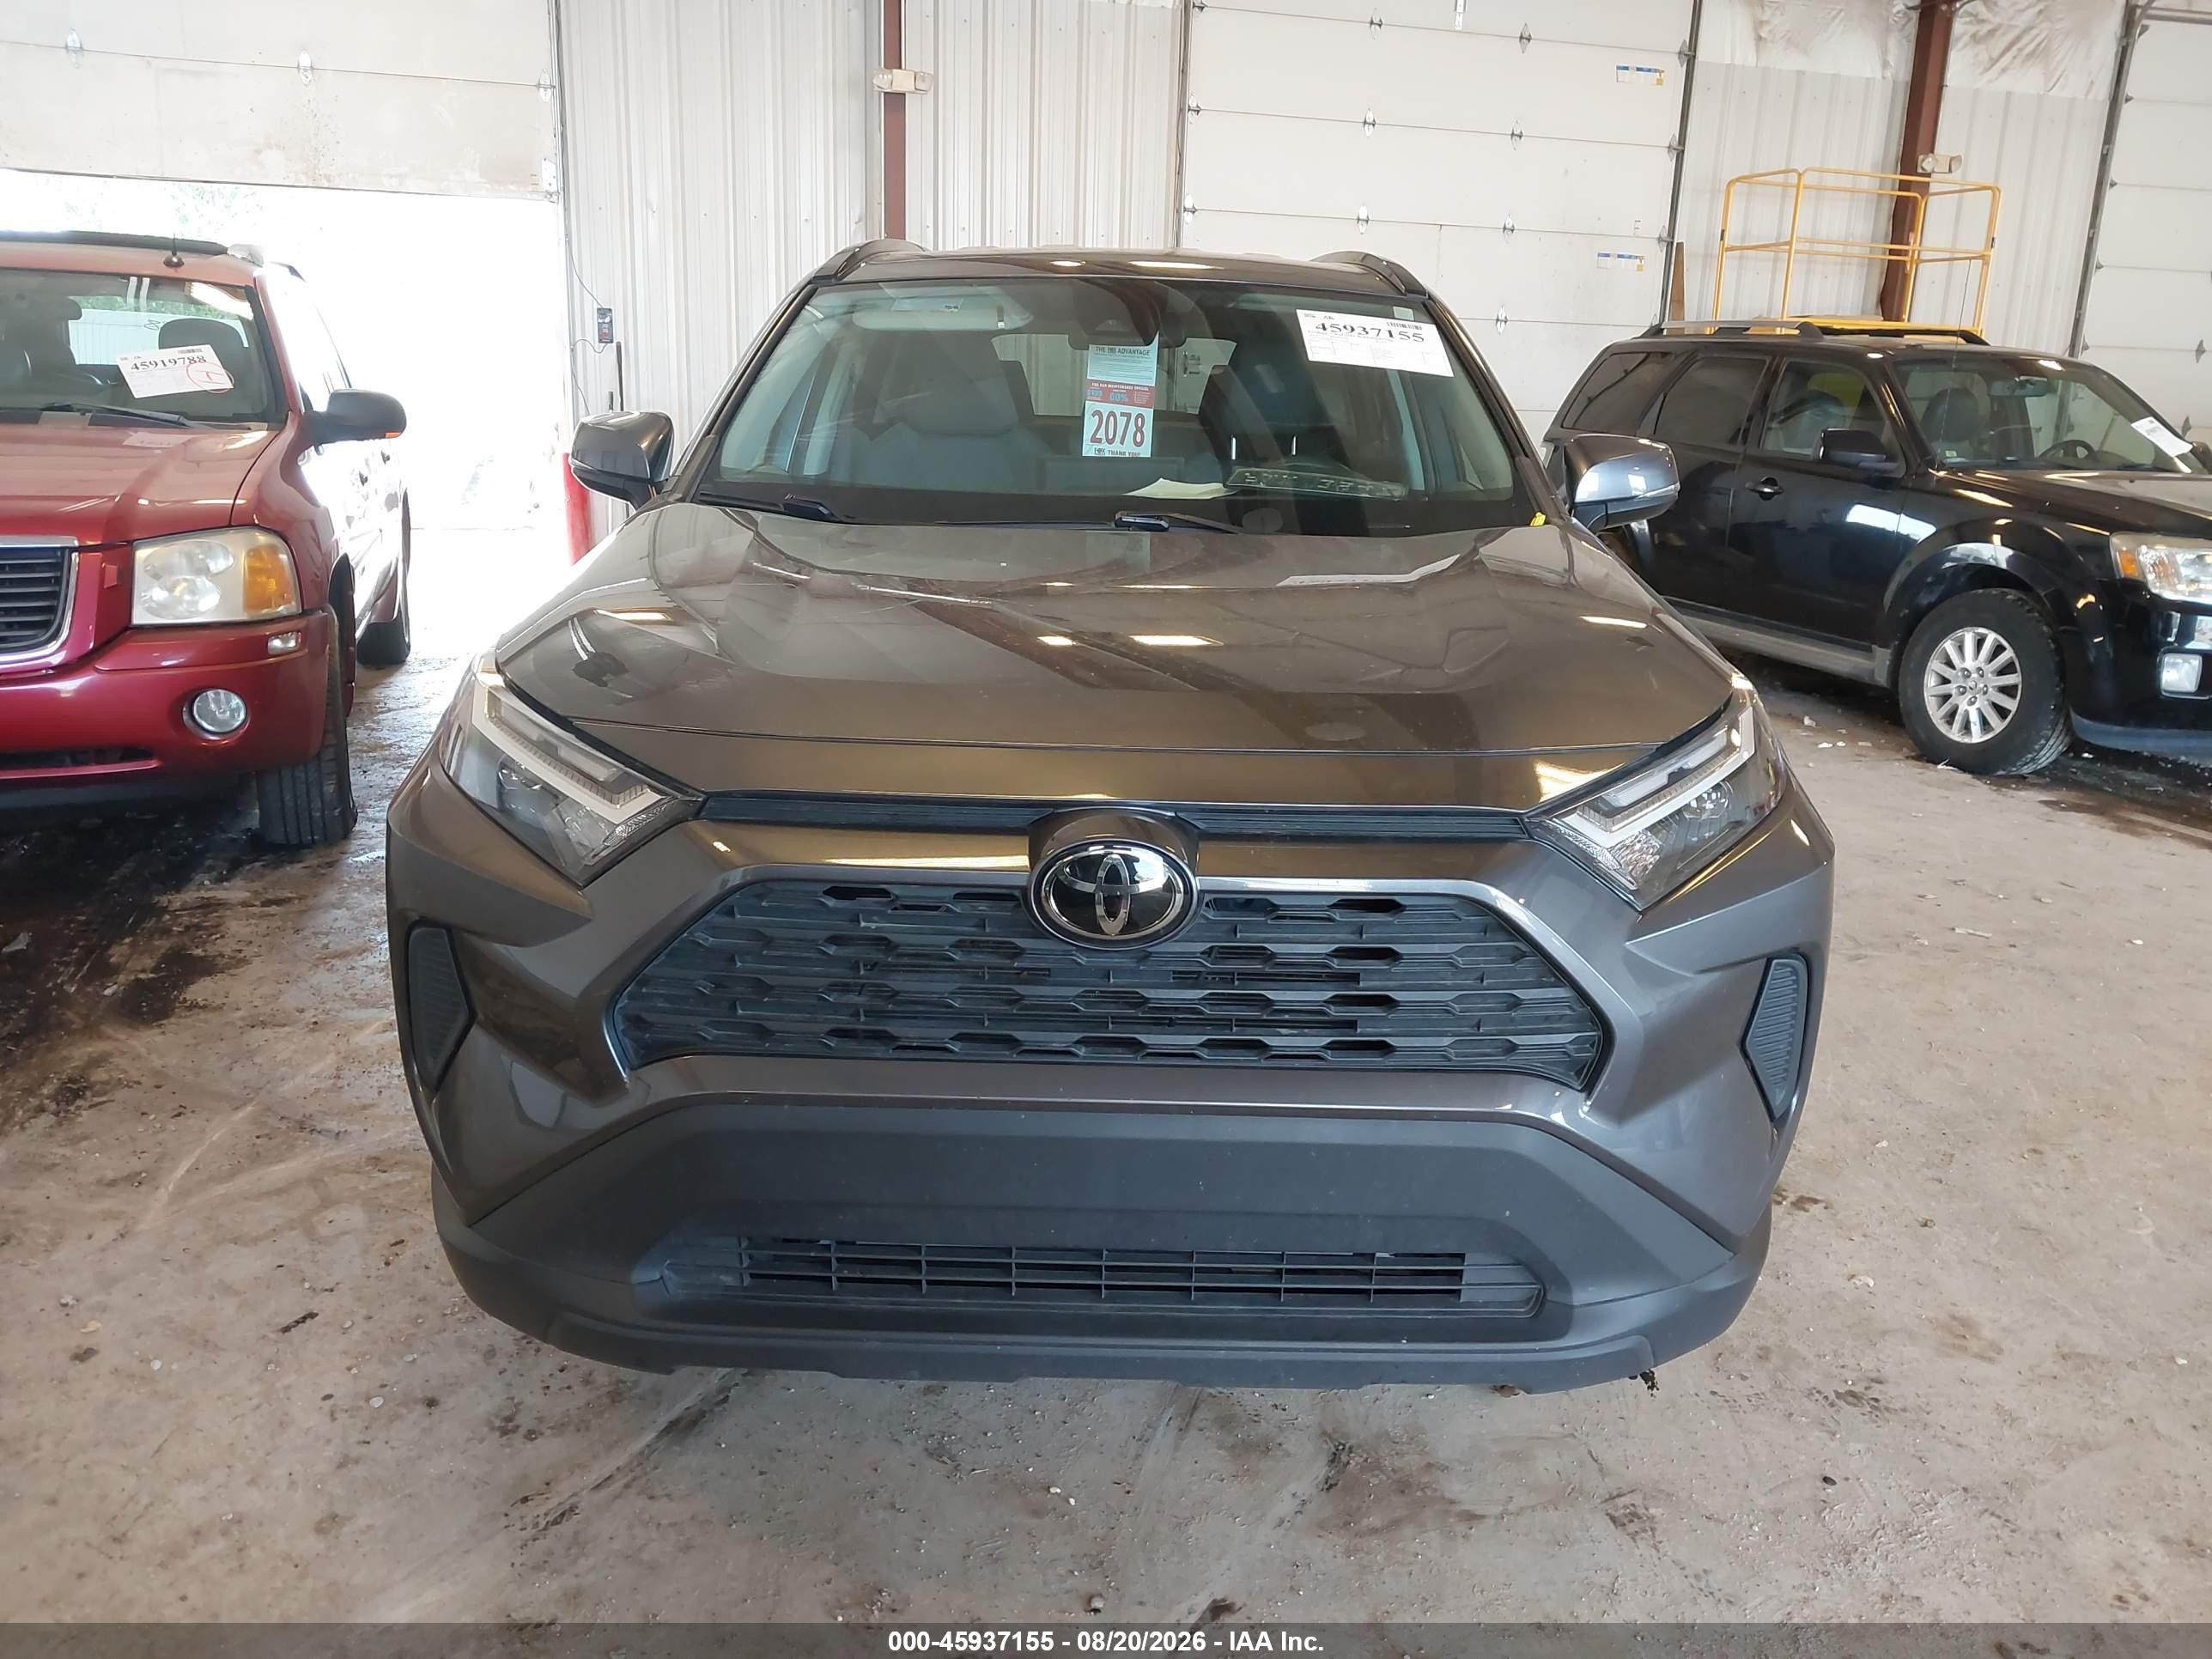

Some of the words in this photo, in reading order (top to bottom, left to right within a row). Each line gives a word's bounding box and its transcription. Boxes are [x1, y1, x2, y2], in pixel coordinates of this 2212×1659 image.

[1315, 321, 1425, 343] 45937155
[1117, 347, 1151, 356] ADVANTAGE
[131, 355, 207, 371] 45919788
[1090, 410, 1146, 447] 2078
